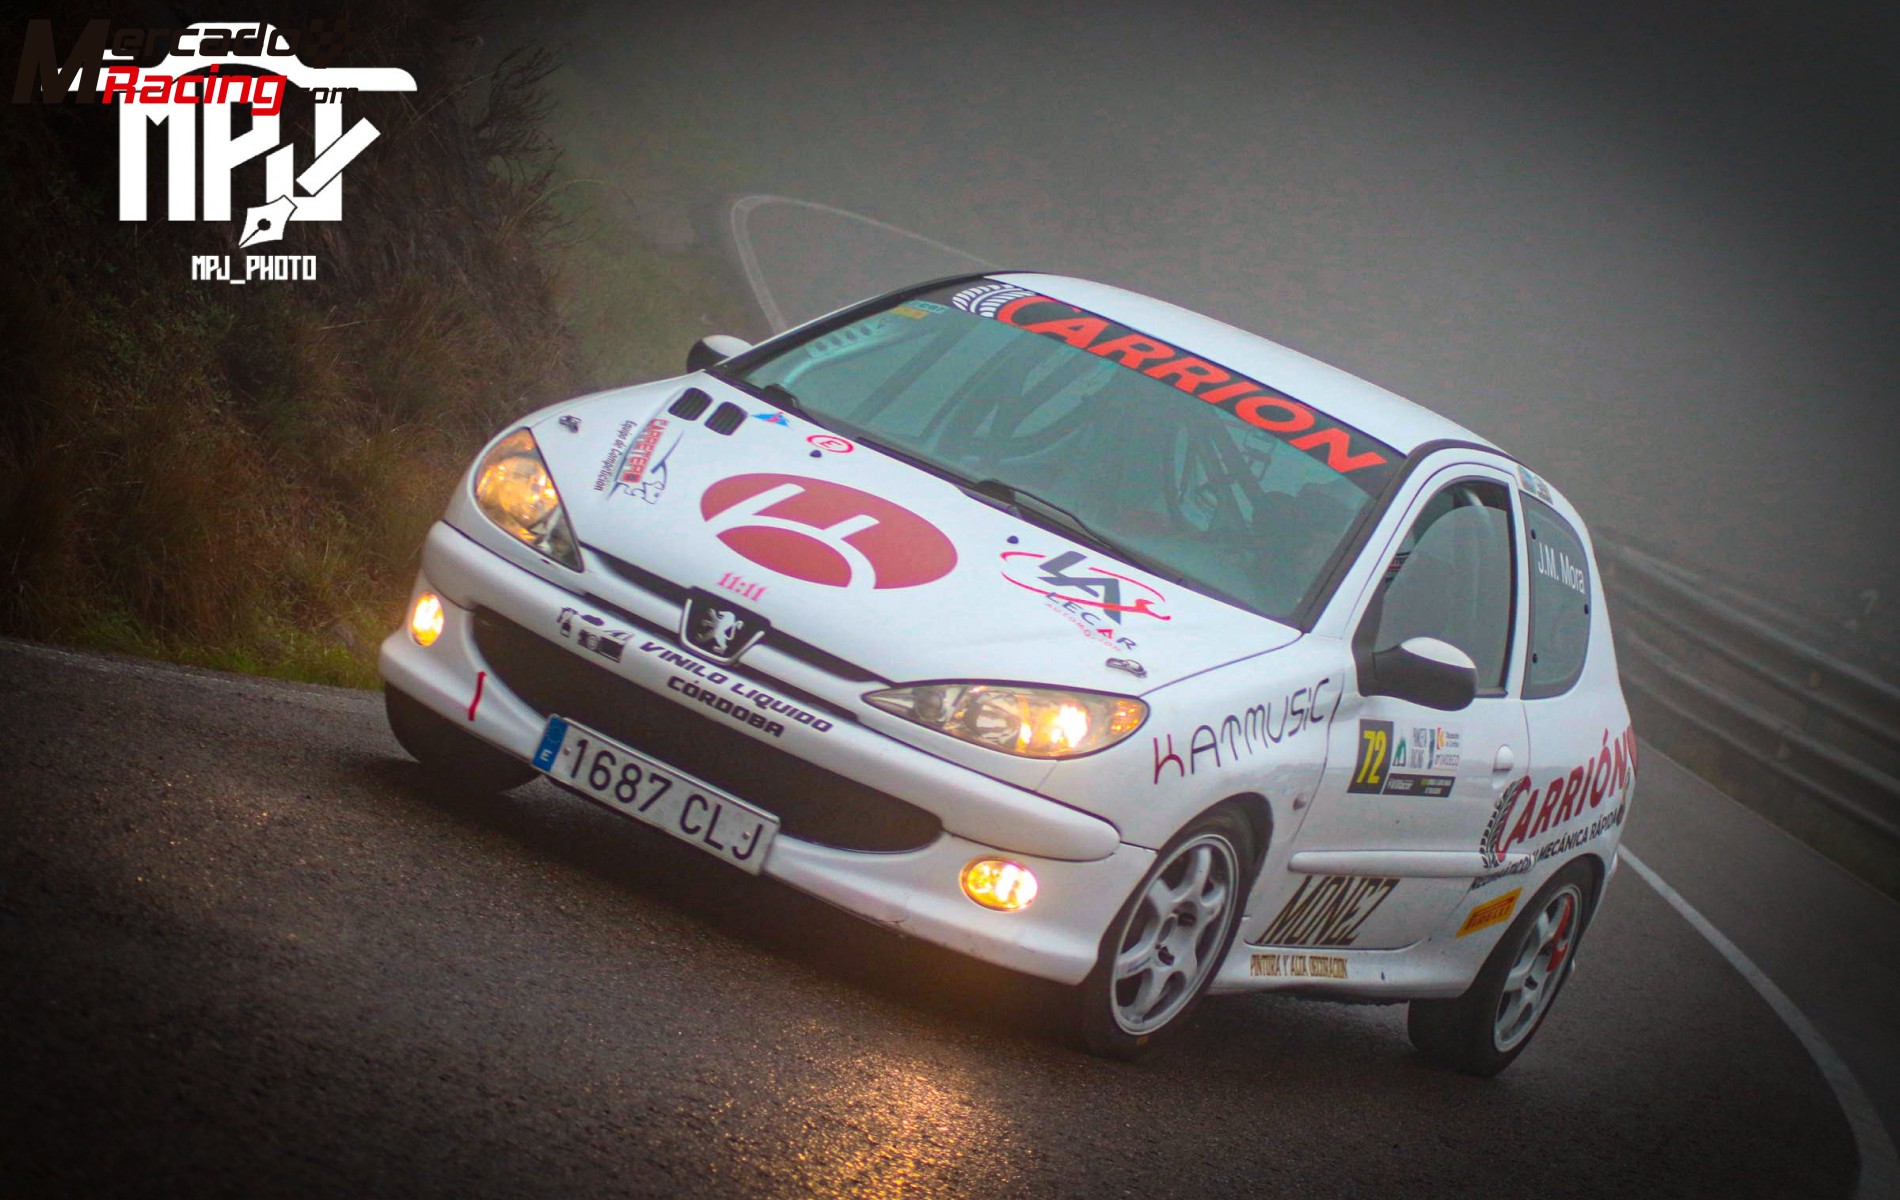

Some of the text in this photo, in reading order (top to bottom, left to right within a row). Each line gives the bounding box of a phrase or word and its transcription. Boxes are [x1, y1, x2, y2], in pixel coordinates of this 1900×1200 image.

[997, 294, 1388, 474] CARRION
[611, 439, 628, 449] de
[717, 572, 769, 602] 11:11
[1538, 542, 1586, 595] J.M. Mora
[1046, 592, 1137, 651] LECAR
[639, 641, 834, 733] VINILO LIQUIDO
[540, 748, 553, 763] E
[1357, 730, 1388, 784] 72
[570, 738, 765, 861] 1687 CLJ
[1494, 728, 1627, 862] CARRIÓN
[1537, 825, 1588, 864] MECÁNICA
